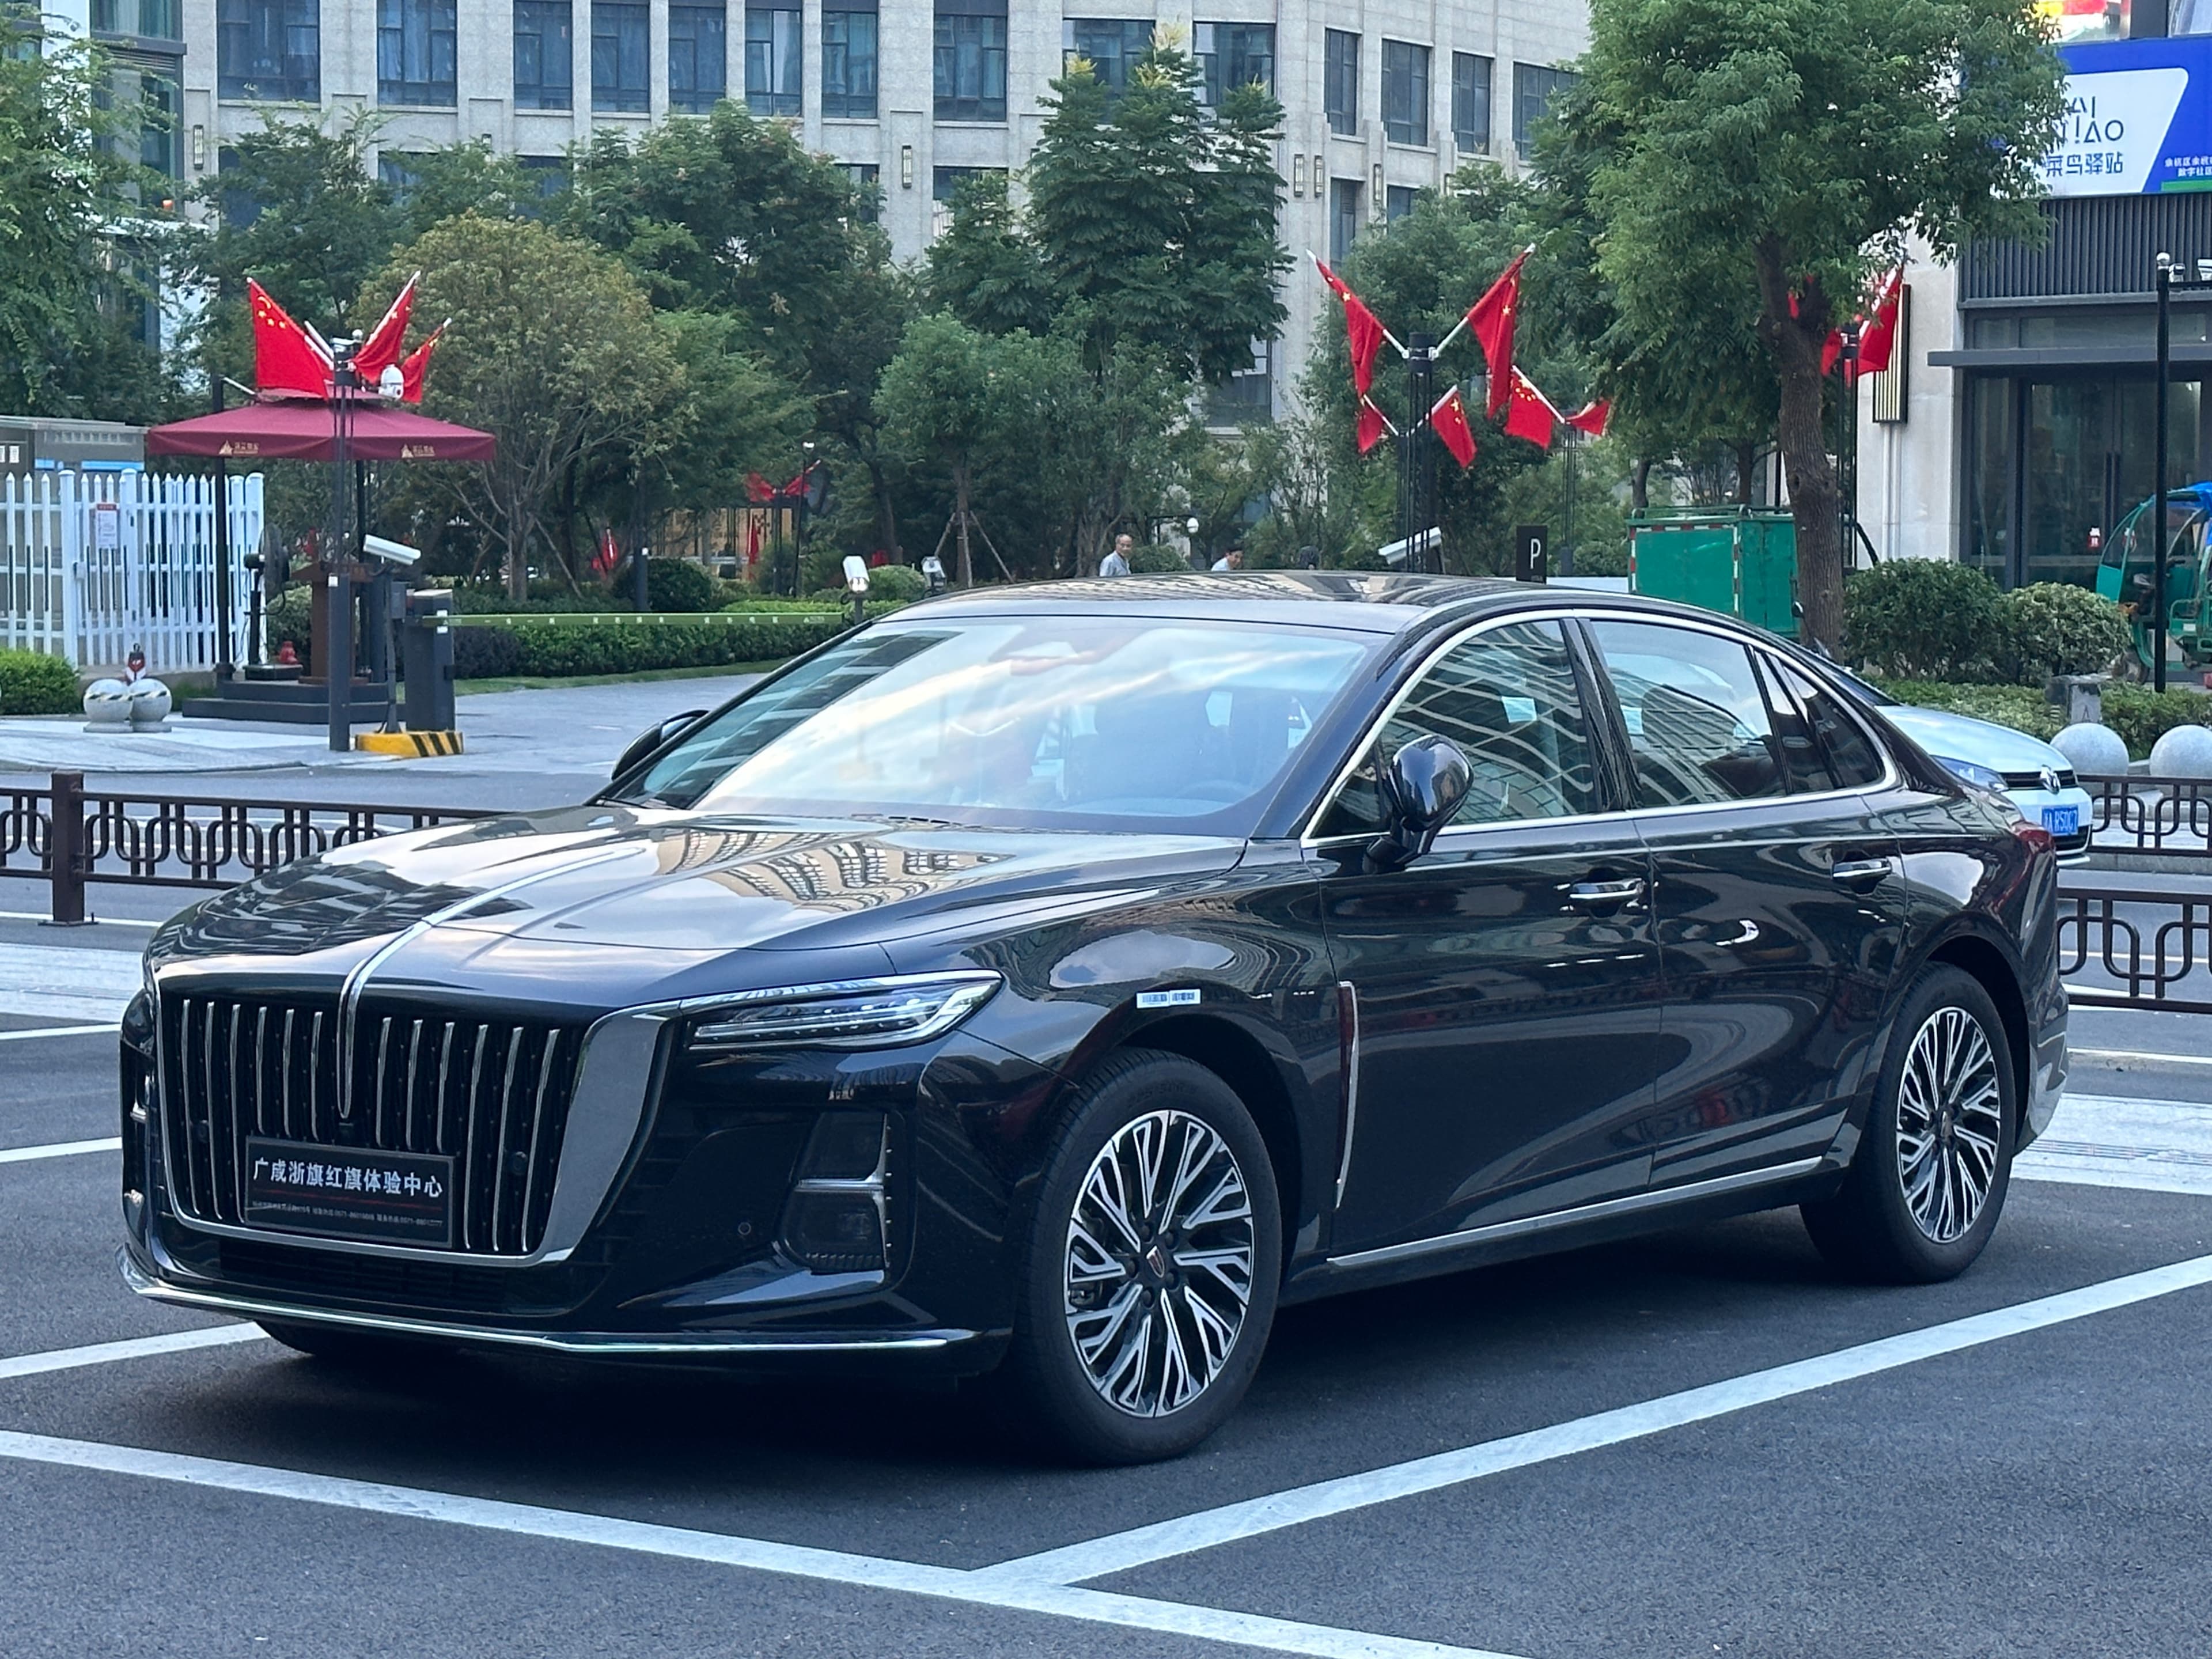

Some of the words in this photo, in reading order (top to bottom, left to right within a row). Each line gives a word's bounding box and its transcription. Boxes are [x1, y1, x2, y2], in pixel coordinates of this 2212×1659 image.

[2046, 151, 2123, 177] 菜鸟驿站
[1530, 538, 1541, 569] P
